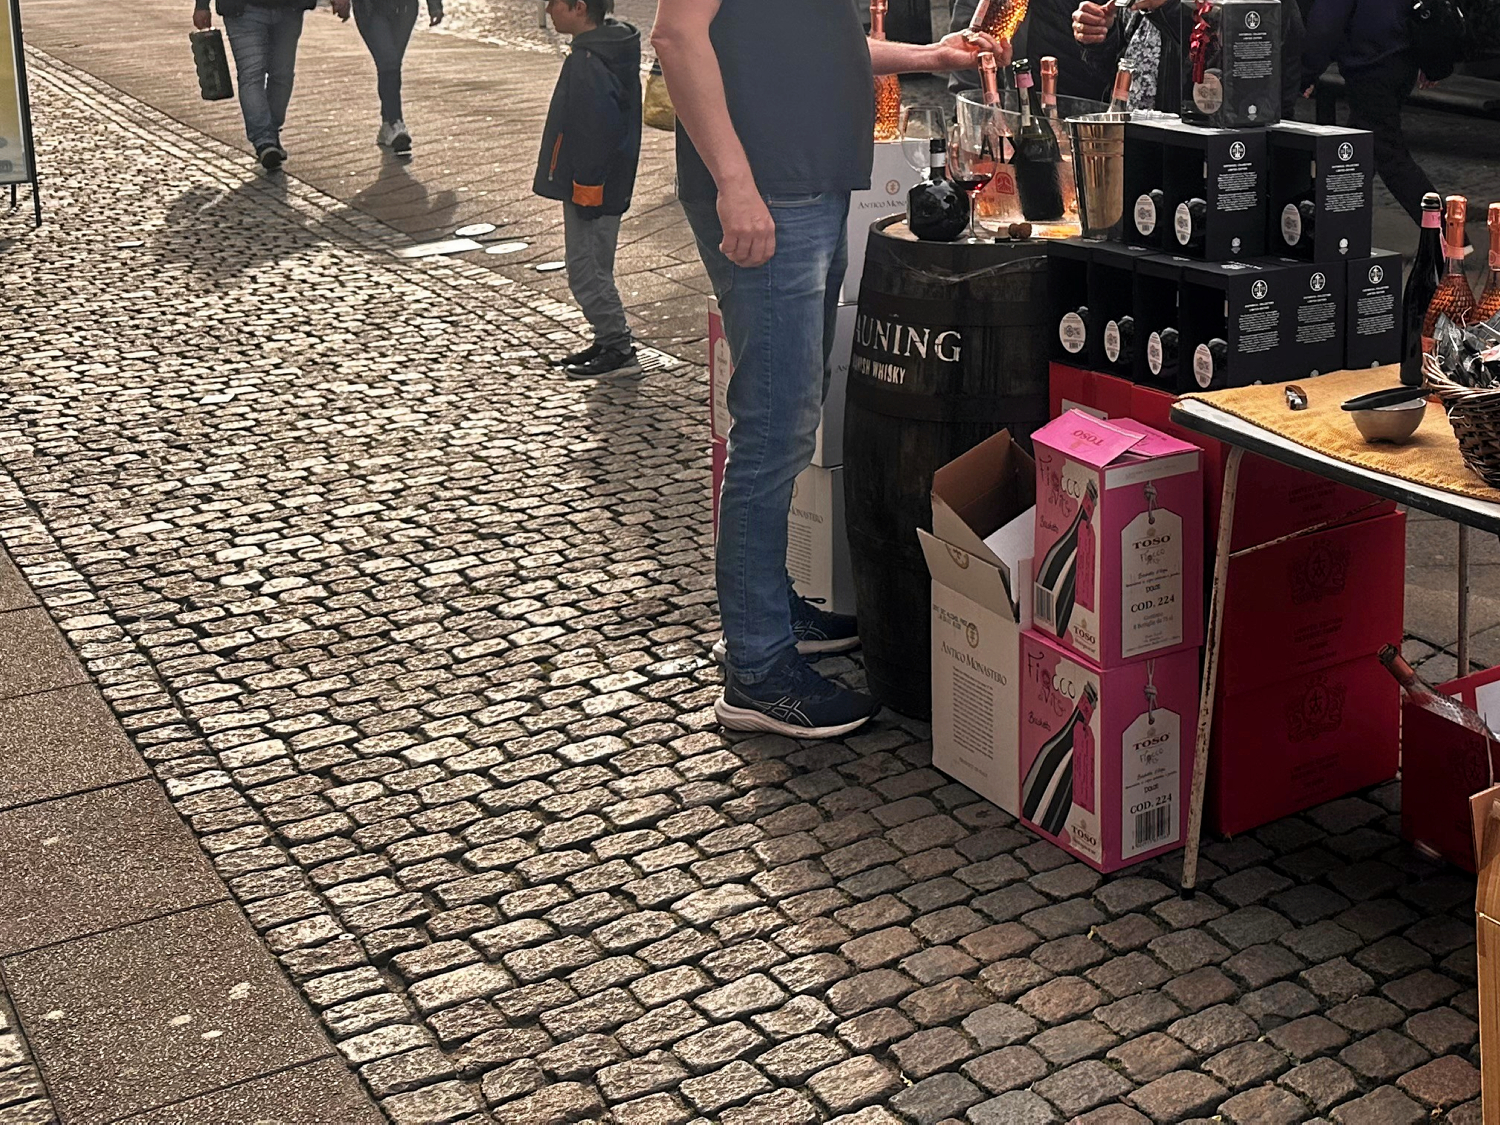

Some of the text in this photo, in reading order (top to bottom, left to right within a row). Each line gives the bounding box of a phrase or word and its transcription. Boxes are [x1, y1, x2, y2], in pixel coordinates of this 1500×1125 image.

[872, 360, 906, 385] WHISKY
[1073, 430, 1104, 446] TOSO
[1132, 535, 1171, 550] TOSO
[1131, 594, 1175, 613] COD. 224
[1073, 625, 1096, 645] TOSO
[1132, 734, 1169, 750] TOSO
[1130, 793, 1172, 814] COD. 224
[1071, 825, 1096, 846] TOSO
